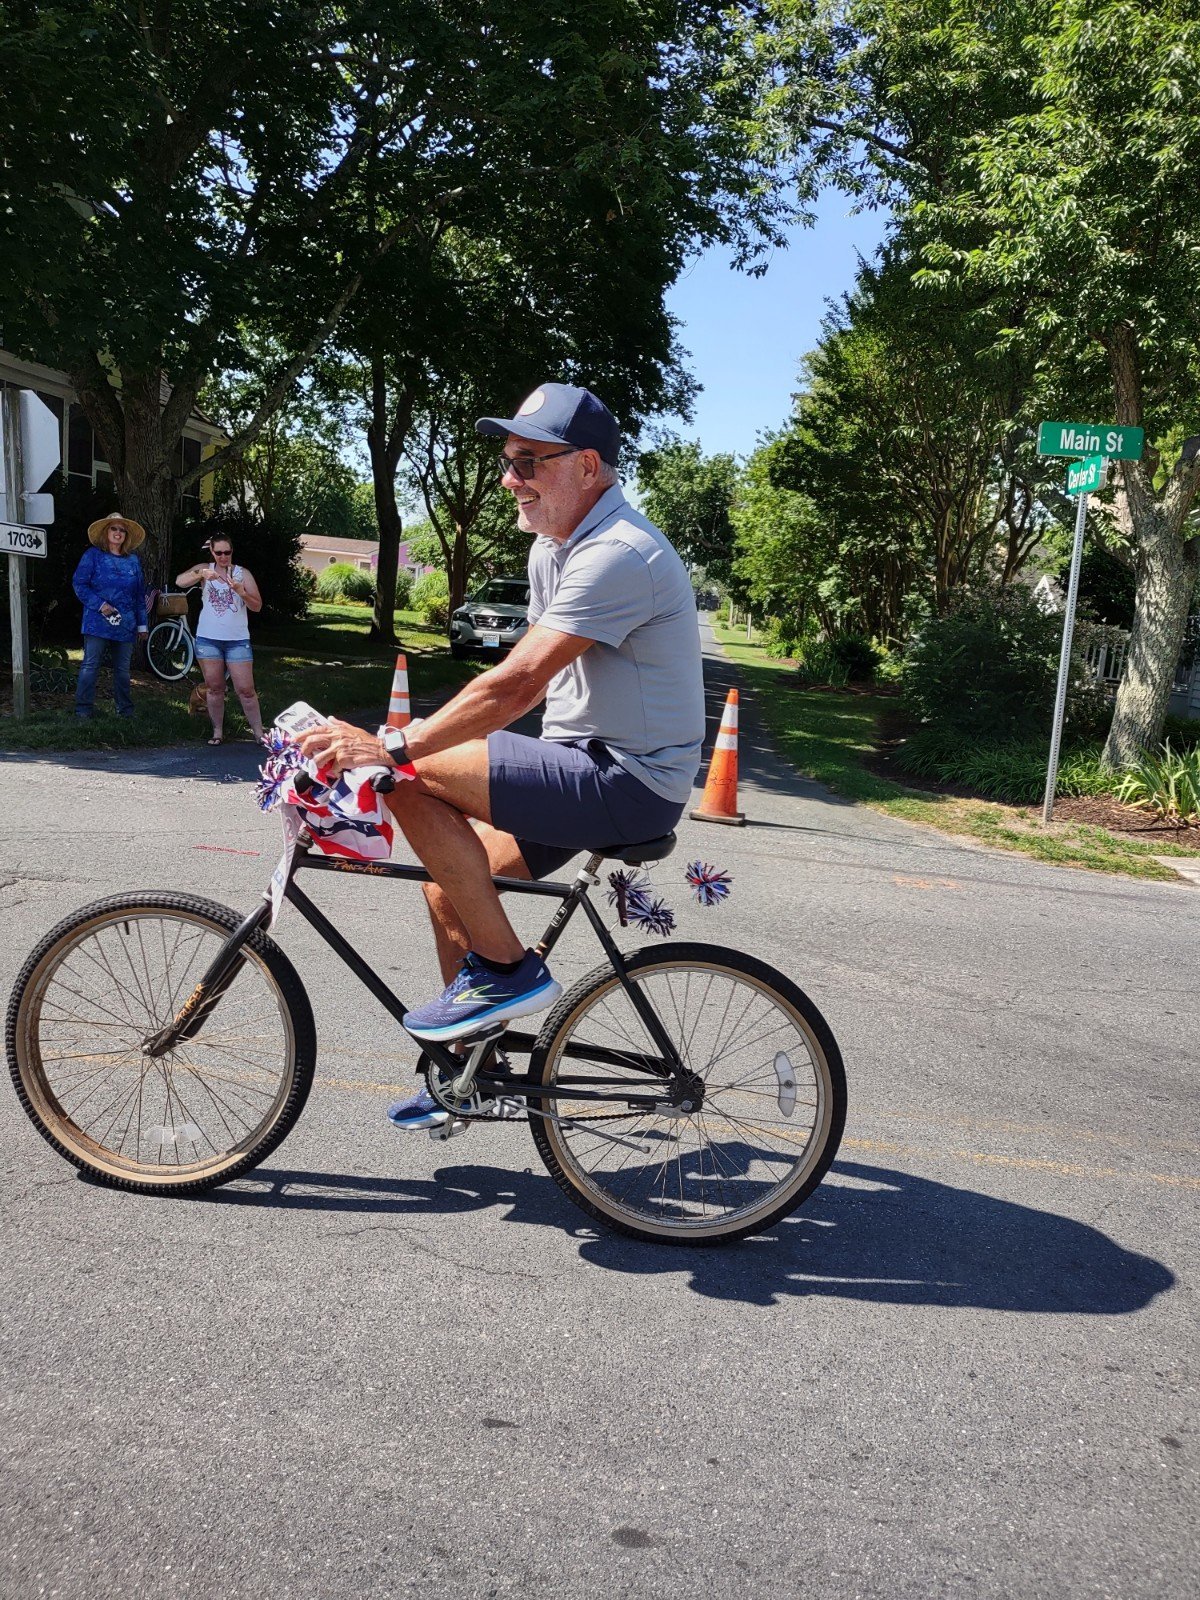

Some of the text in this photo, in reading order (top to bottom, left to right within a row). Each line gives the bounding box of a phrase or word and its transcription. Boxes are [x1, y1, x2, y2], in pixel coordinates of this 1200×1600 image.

[1060, 429, 1123, 452] Main St
[1088, 463, 1096, 484] St
[7, 531, 33, 548] 1703
